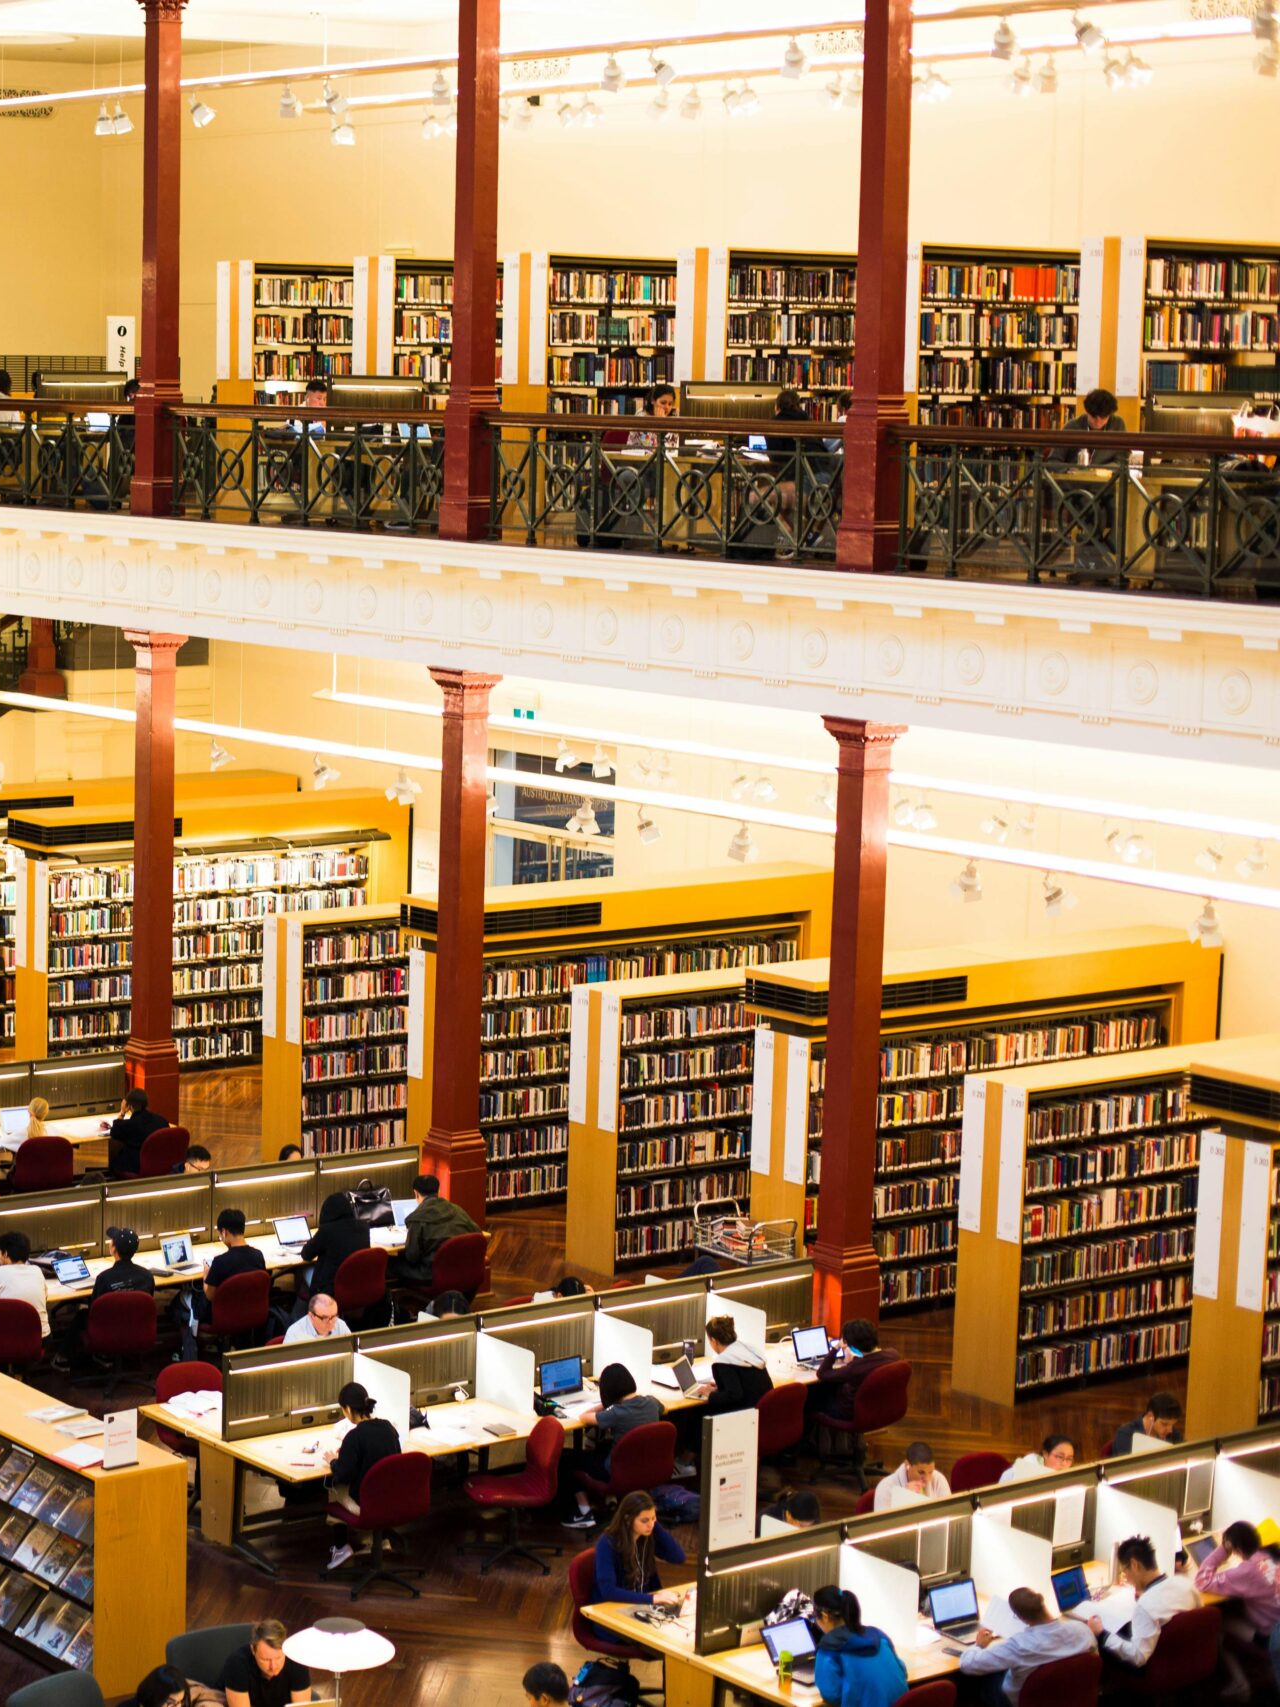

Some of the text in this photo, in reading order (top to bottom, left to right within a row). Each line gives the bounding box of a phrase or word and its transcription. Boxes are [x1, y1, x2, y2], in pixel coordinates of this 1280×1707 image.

[118, 345, 126, 368] Help
[521, 787, 609, 810] AUSTRALIAN MANUSRIPTS
[715, 1453, 728, 1461] Public
